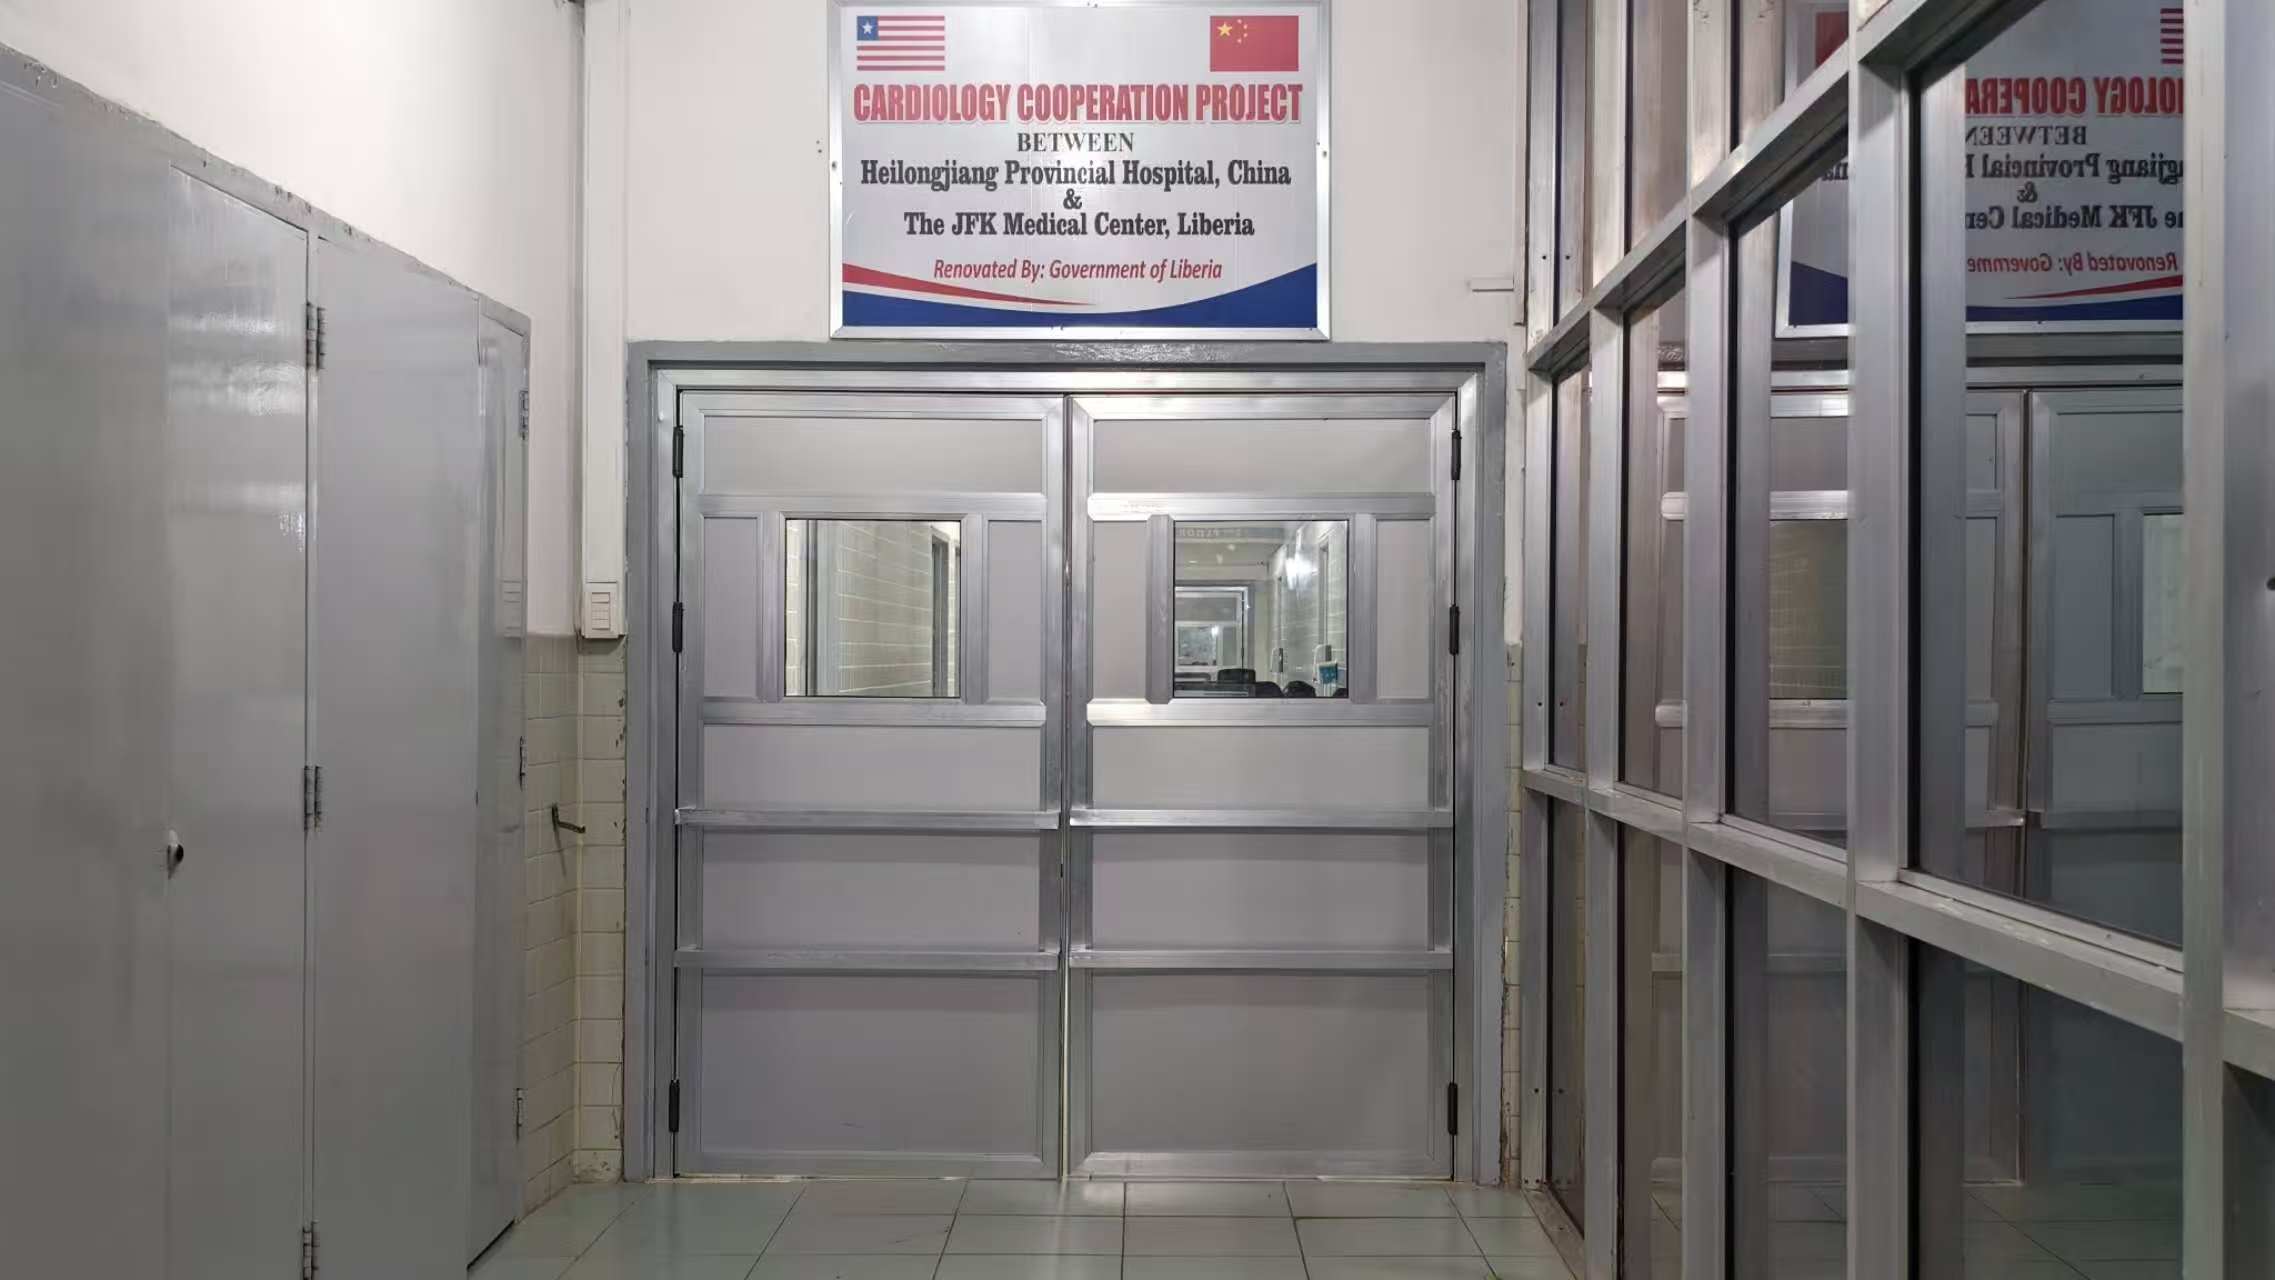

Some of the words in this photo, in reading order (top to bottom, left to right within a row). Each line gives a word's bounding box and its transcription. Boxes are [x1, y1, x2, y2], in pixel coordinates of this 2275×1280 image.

[853, 84, 1011, 121] CARDIOLOGY
[1017, 84, 1189, 121] COOPERATION
[1196, 84, 1303, 121] PROJECT
[1017, 132, 1134, 152] BETWEEN
[861, 160, 999, 191] Heilongjiang
[1005, 160, 1115, 185] Provincial
[1122, 160, 1220, 191] Hospital,
[1227, 160, 1291, 185] China
[1063, 188, 1082, 210] &
[904, 212, 944, 236] The
[952, 212, 997, 236] JFK
[1003, 212, 1087, 236] Medical
[1094, 212, 1170, 238] Center,
[1177, 212, 1254, 236] Liberia
[934, 259, 1017, 279] Renovated
[1021, 260, 1045, 283] By:
[1049, 260, 1145, 279] Government
[1150, 259, 1167, 282] of
[1170, 259, 1222, 279] Liberia
